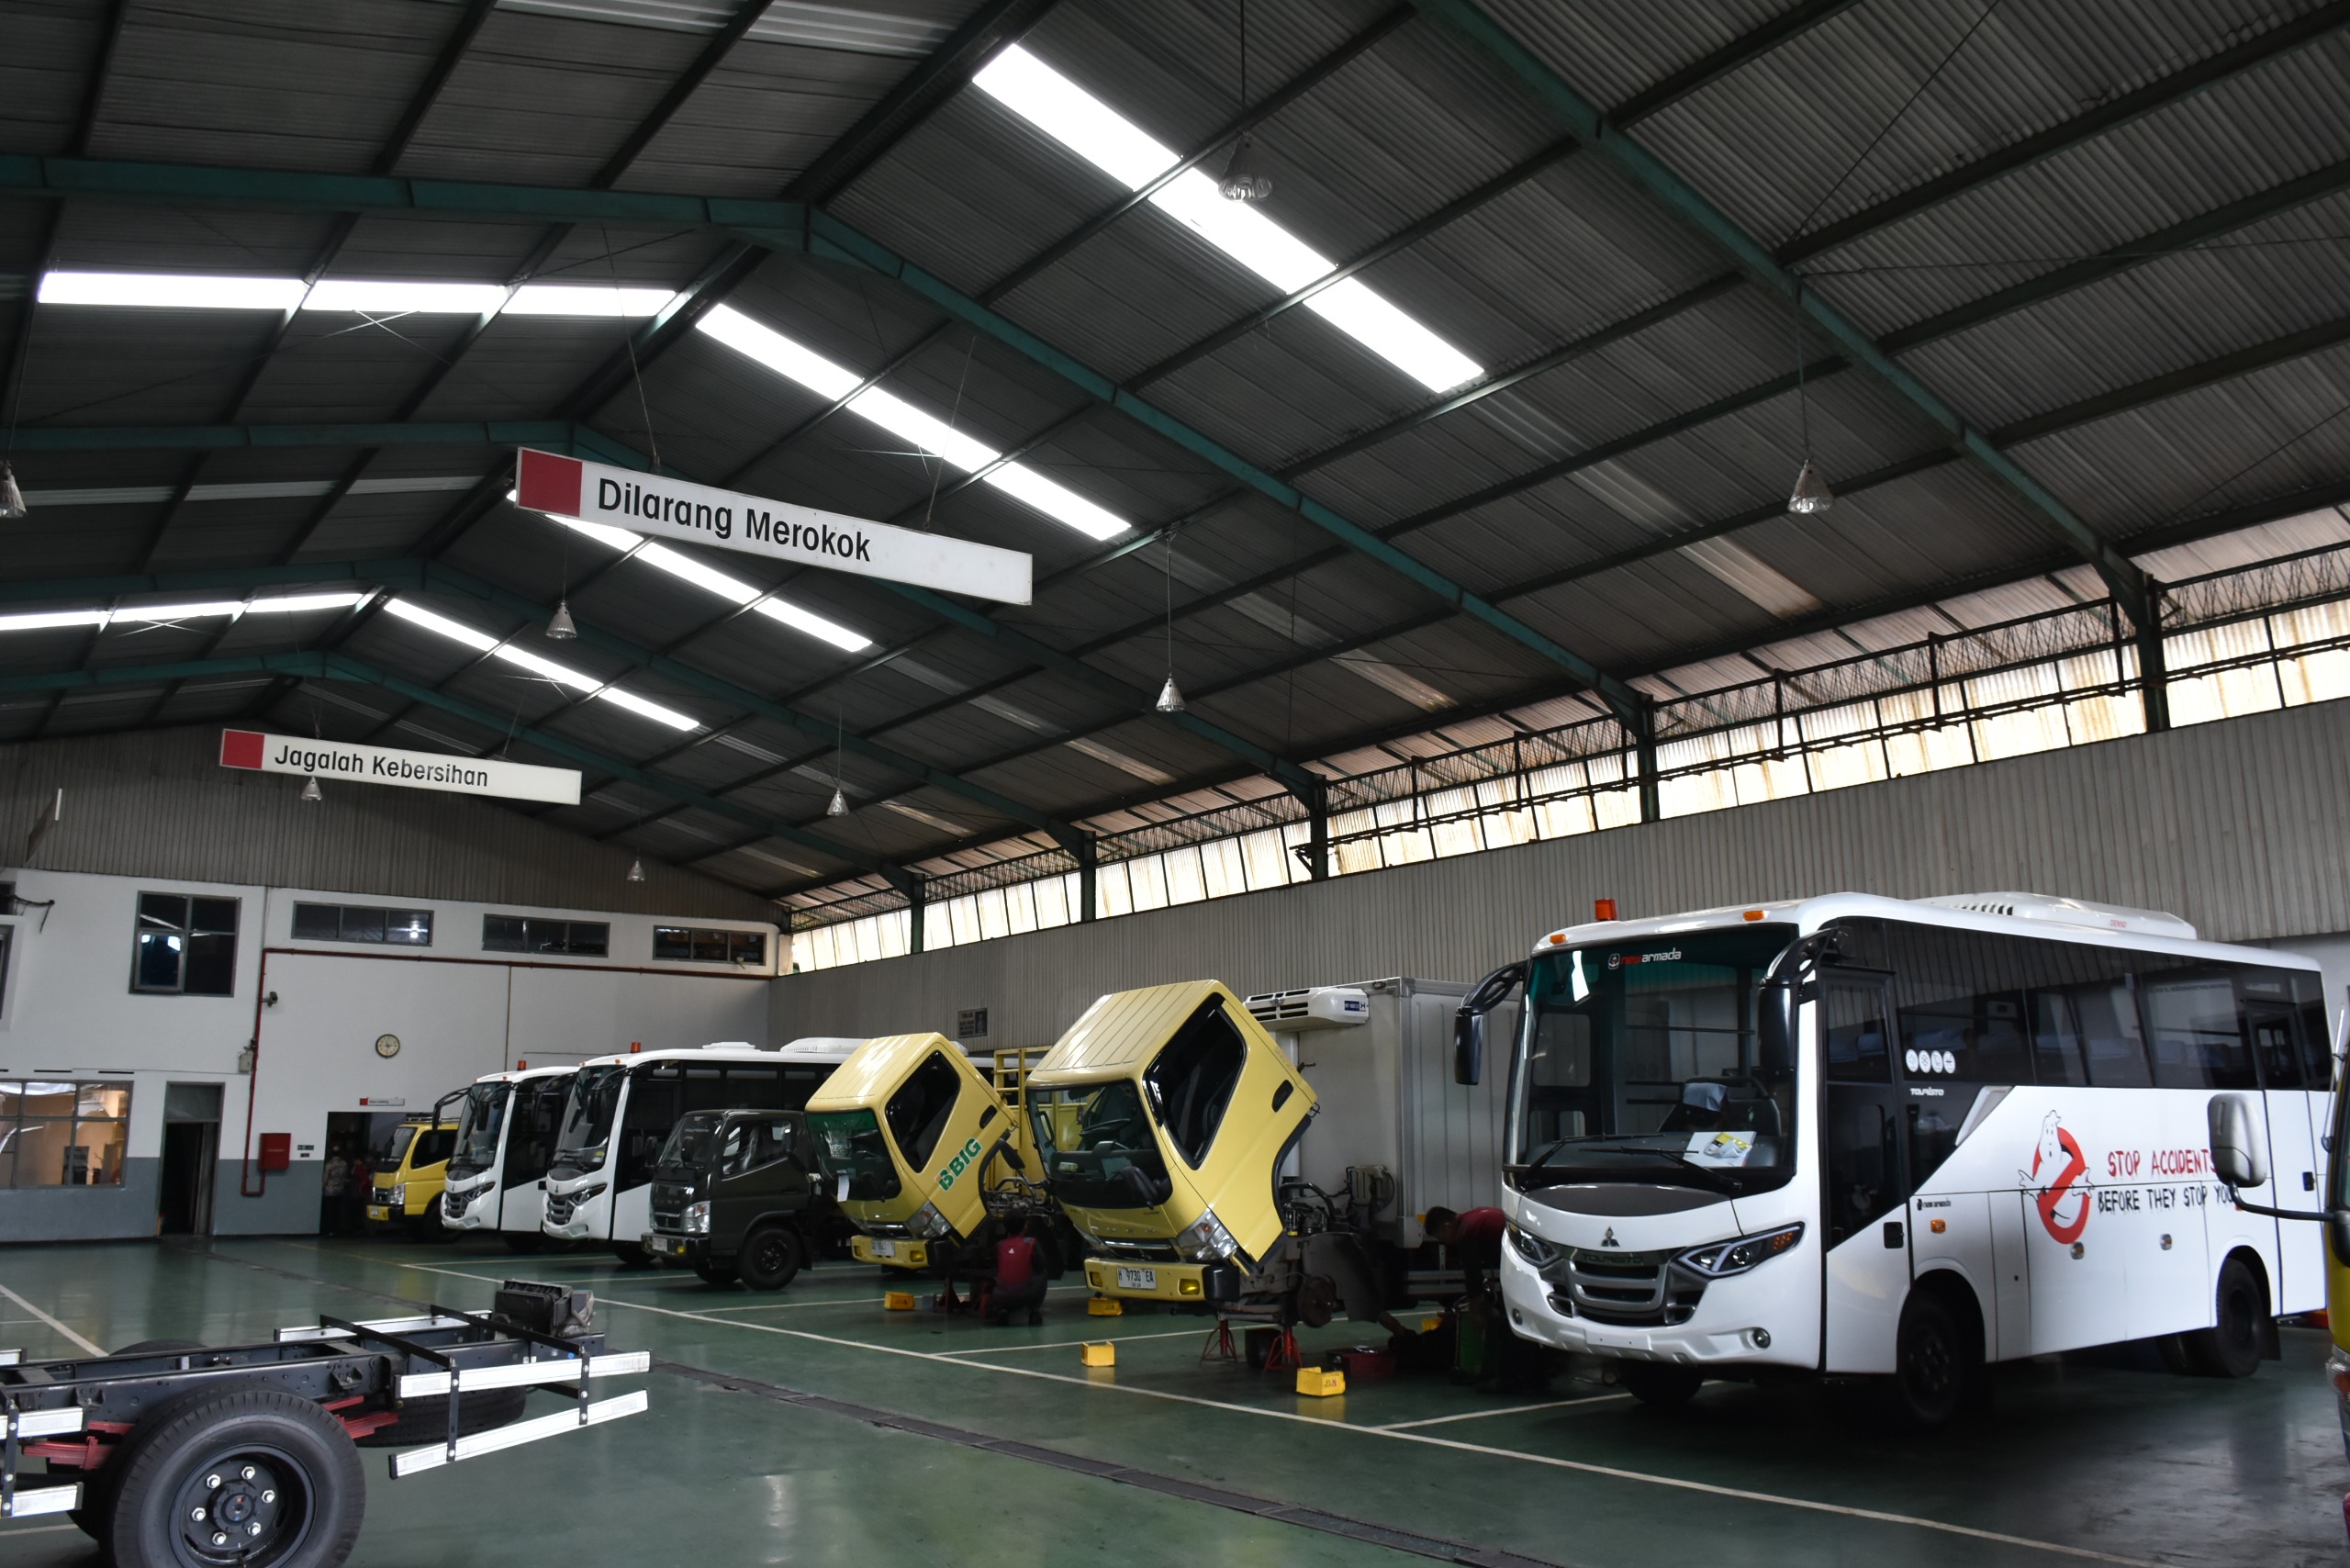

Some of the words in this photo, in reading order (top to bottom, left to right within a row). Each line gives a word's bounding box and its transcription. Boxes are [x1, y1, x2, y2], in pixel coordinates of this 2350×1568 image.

[598, 477, 733, 540] Dilarang
[745, 508, 871, 563] Merokok
[274, 745, 364, 773] Jagalah
[372, 755, 488, 787] Kebersihan
[2107, 1149, 2142, 1178] STOP
[2098, 1188, 2141, 1214] BEFORE
[2146, 1187, 2177, 1210] THEY
[2183, 1184, 2208, 1208] STOP
[1118, 1269, 1123, 1281] H
[1126, 1270, 1141, 1282] 9730
[1146, 1271, 1154, 1282] EA
